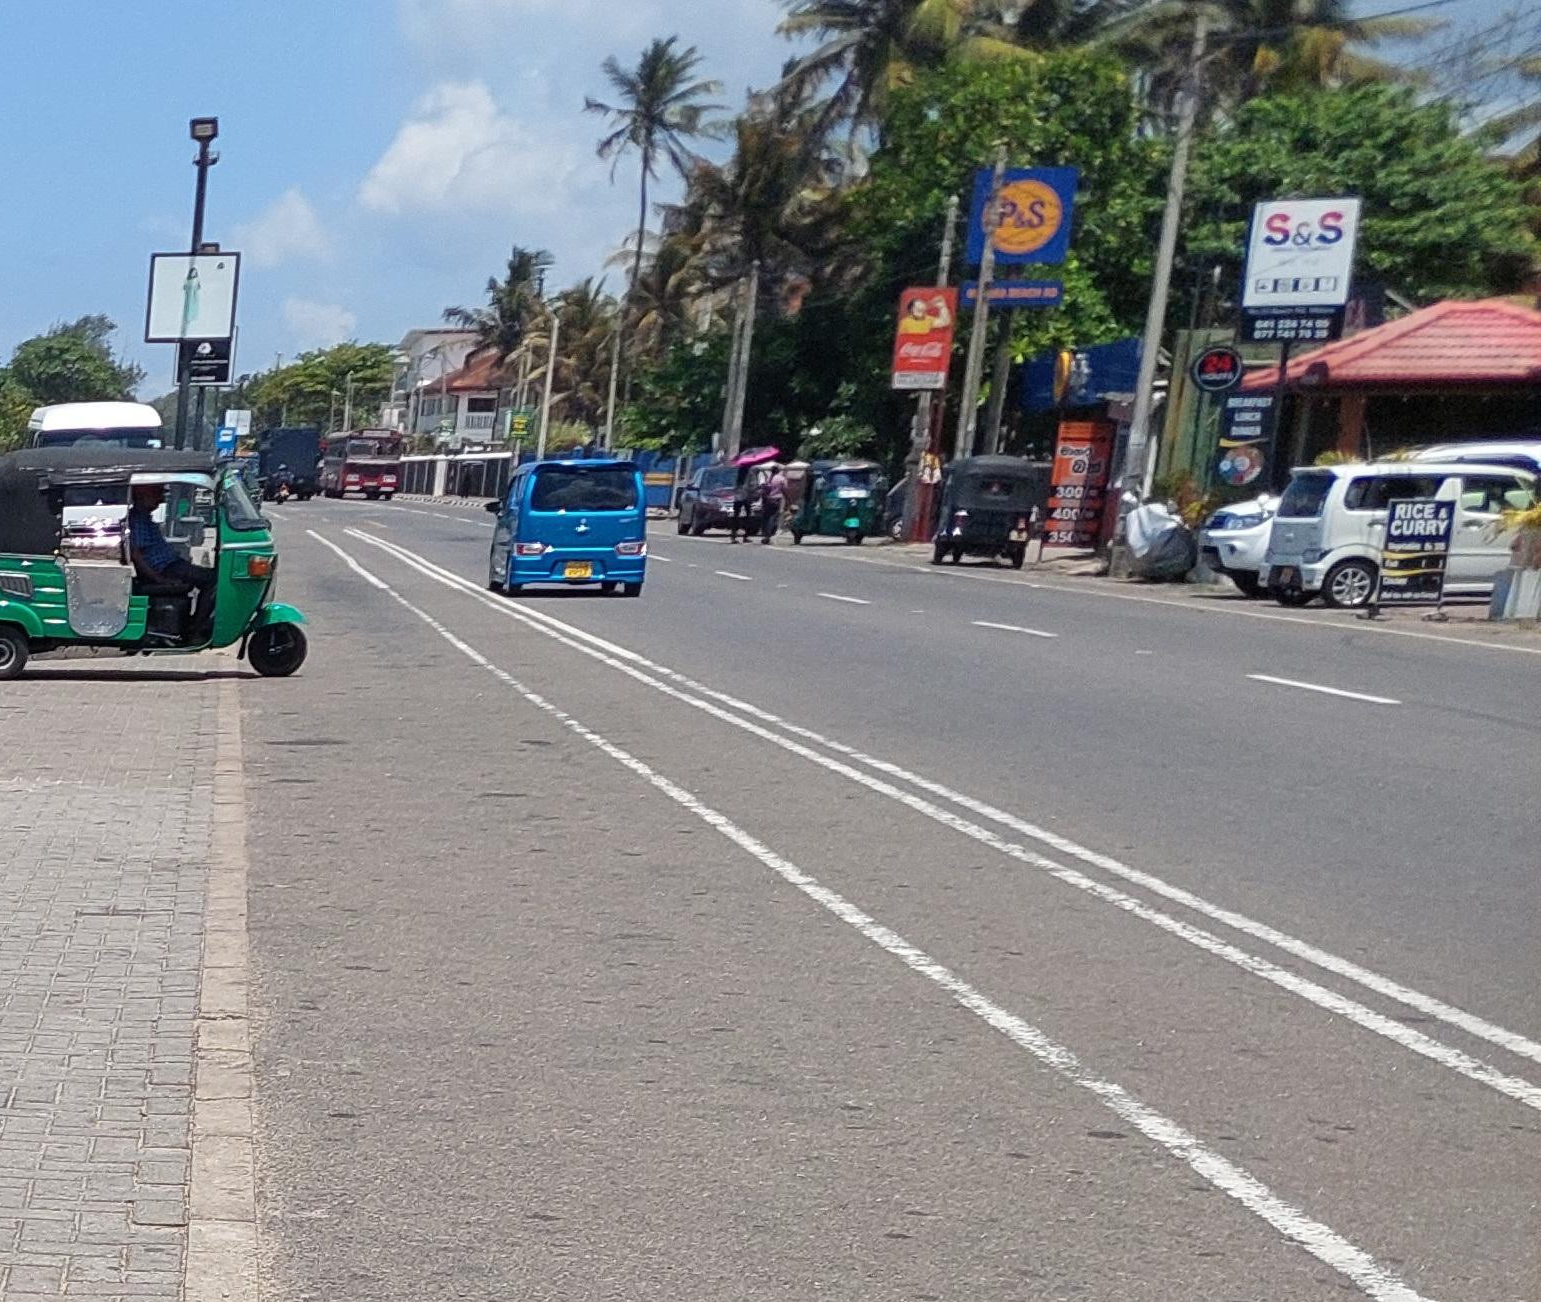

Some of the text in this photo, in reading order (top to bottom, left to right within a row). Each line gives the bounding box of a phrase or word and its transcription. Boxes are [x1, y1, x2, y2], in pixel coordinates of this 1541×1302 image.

[998, 200, 1046, 228] P&S
[1395, 503, 1436, 519] RICE
[1390, 519, 1449, 536] CURRY
